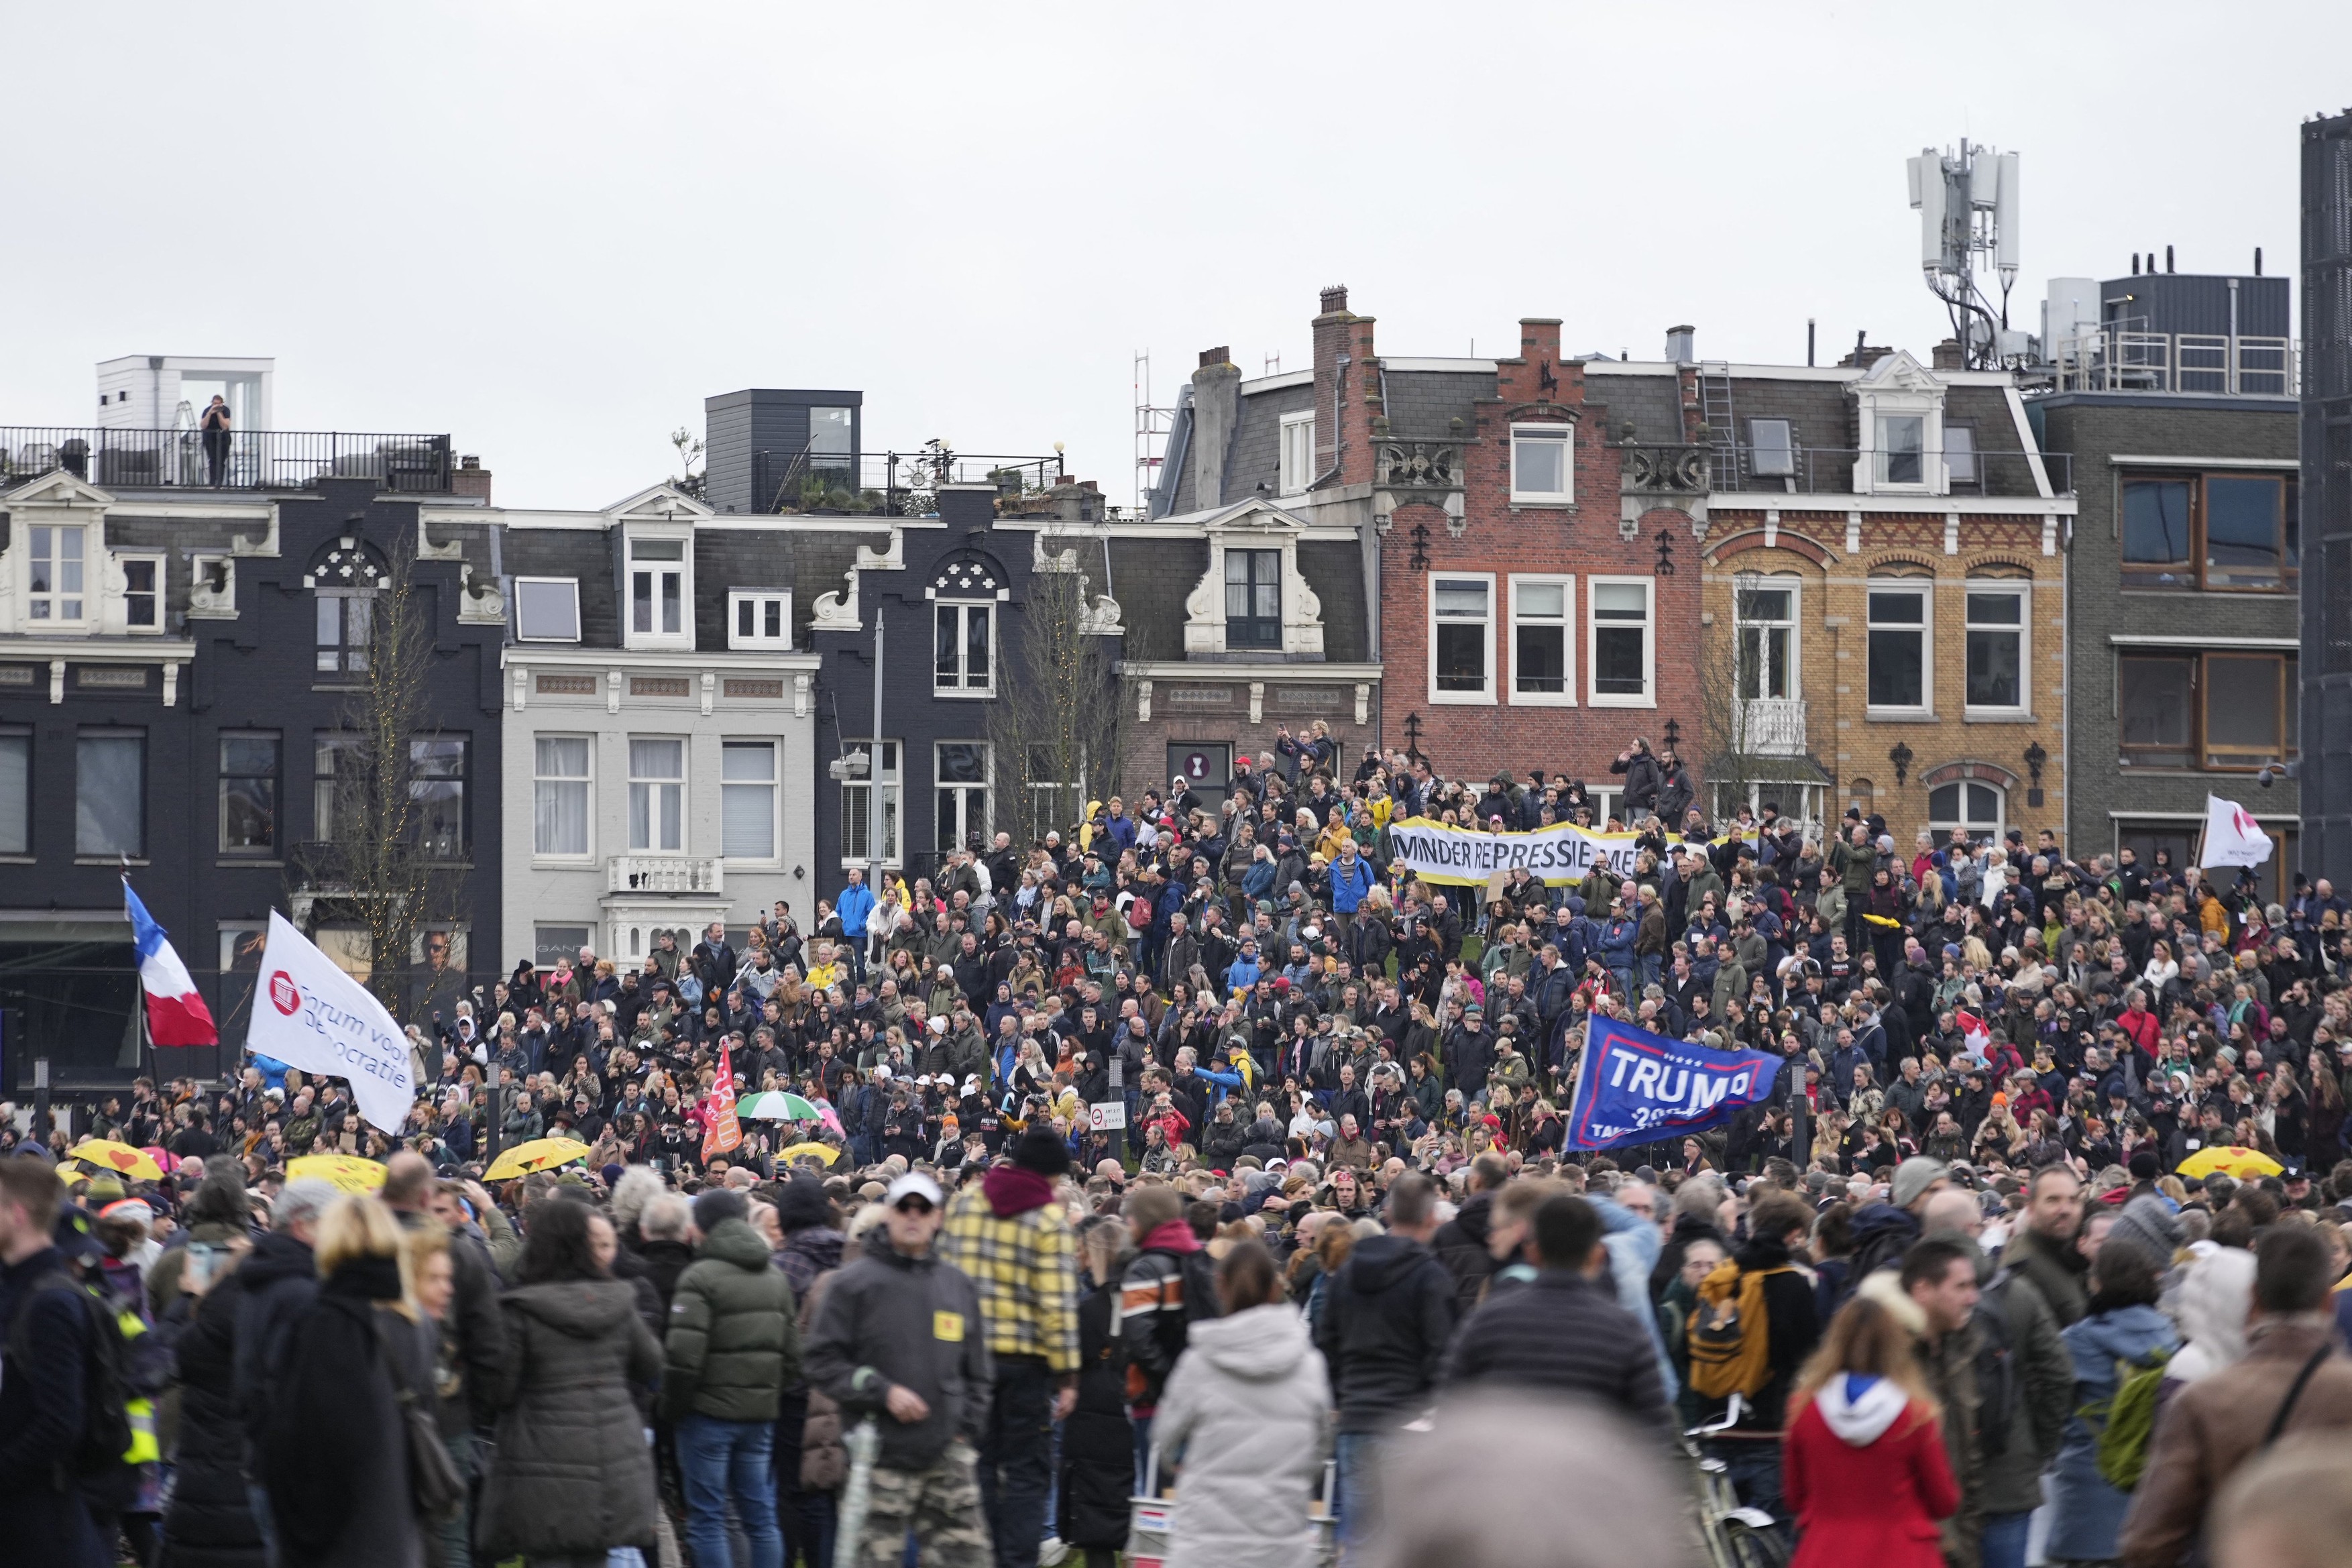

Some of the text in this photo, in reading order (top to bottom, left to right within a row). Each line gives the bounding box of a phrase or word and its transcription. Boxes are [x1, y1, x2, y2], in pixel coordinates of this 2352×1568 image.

[1392, 834, 1471, 869] MINDER
[1475, 840, 1591, 869] REPRESSIE
[304, 1008, 406, 1088] Deocratie
[372, 1028, 407, 1066] voor
[1610, 1048, 1750, 1109] TRUMP
[1636, 1107, 1705, 1127] 20
